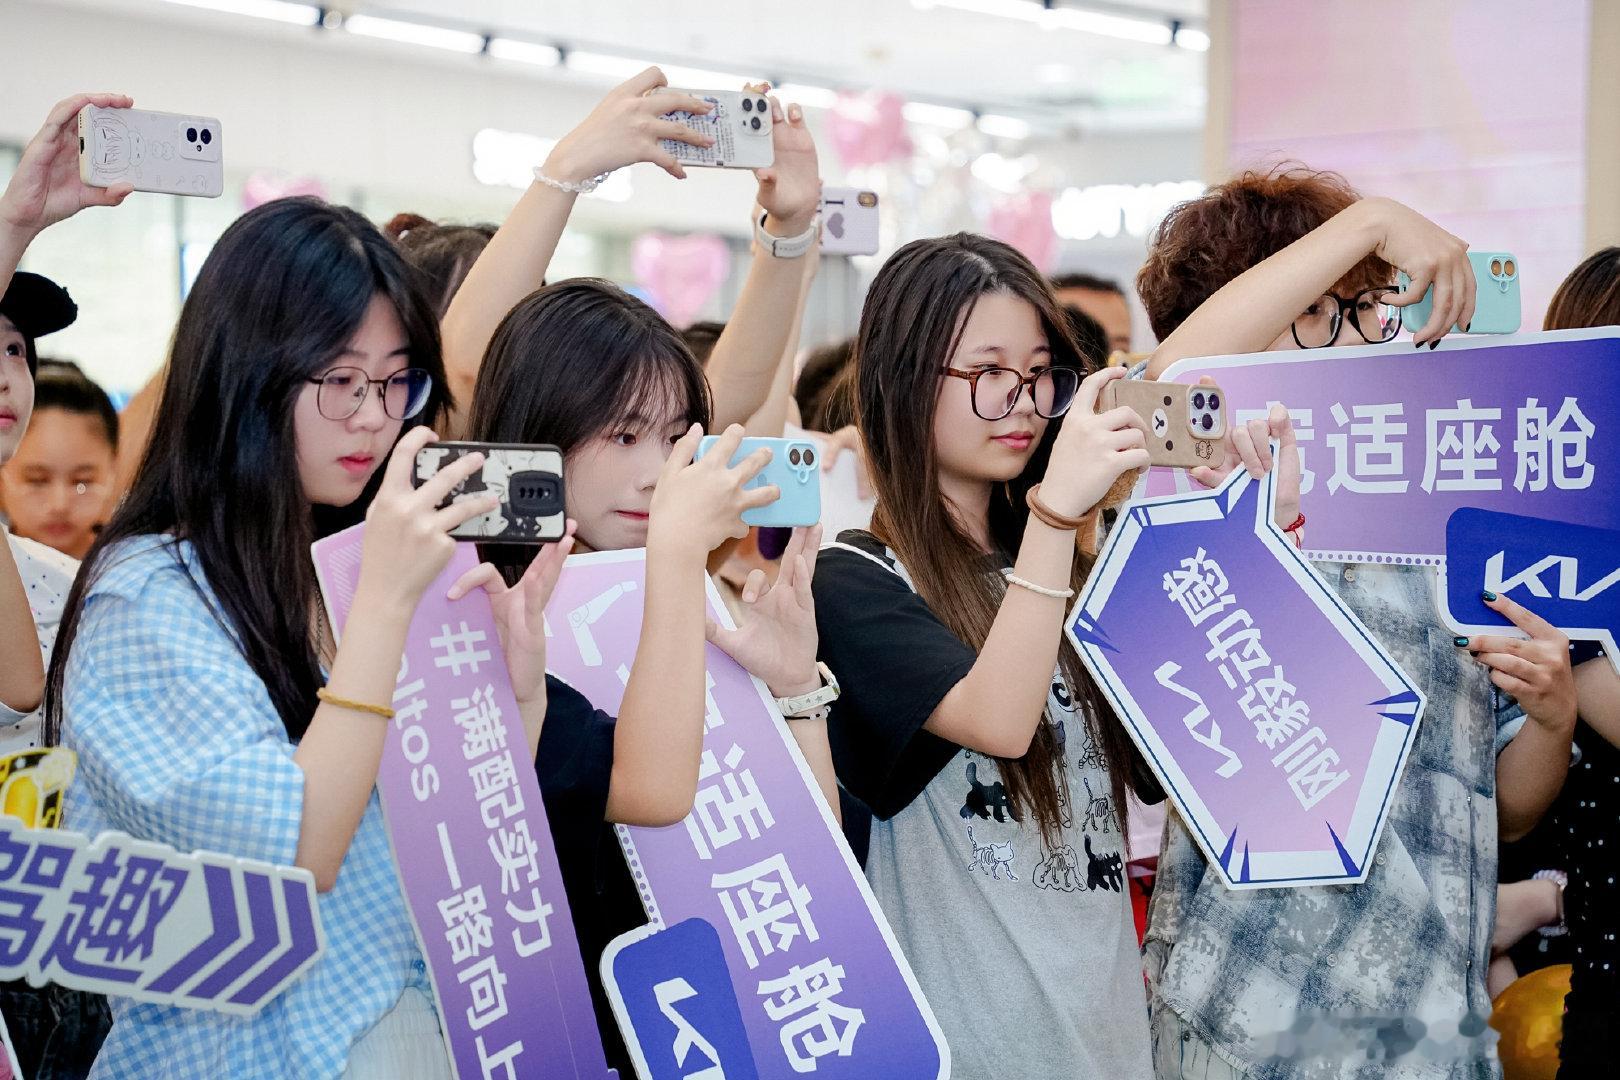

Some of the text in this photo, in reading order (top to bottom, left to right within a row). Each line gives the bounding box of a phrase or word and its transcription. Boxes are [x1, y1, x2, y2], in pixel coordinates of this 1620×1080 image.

[1484, 550, 1620, 602] KI
[1154, 660, 1243, 779] KIA
[1162, 546, 1352, 812] 刚毅动感
[653, 977, 727, 1080] K
